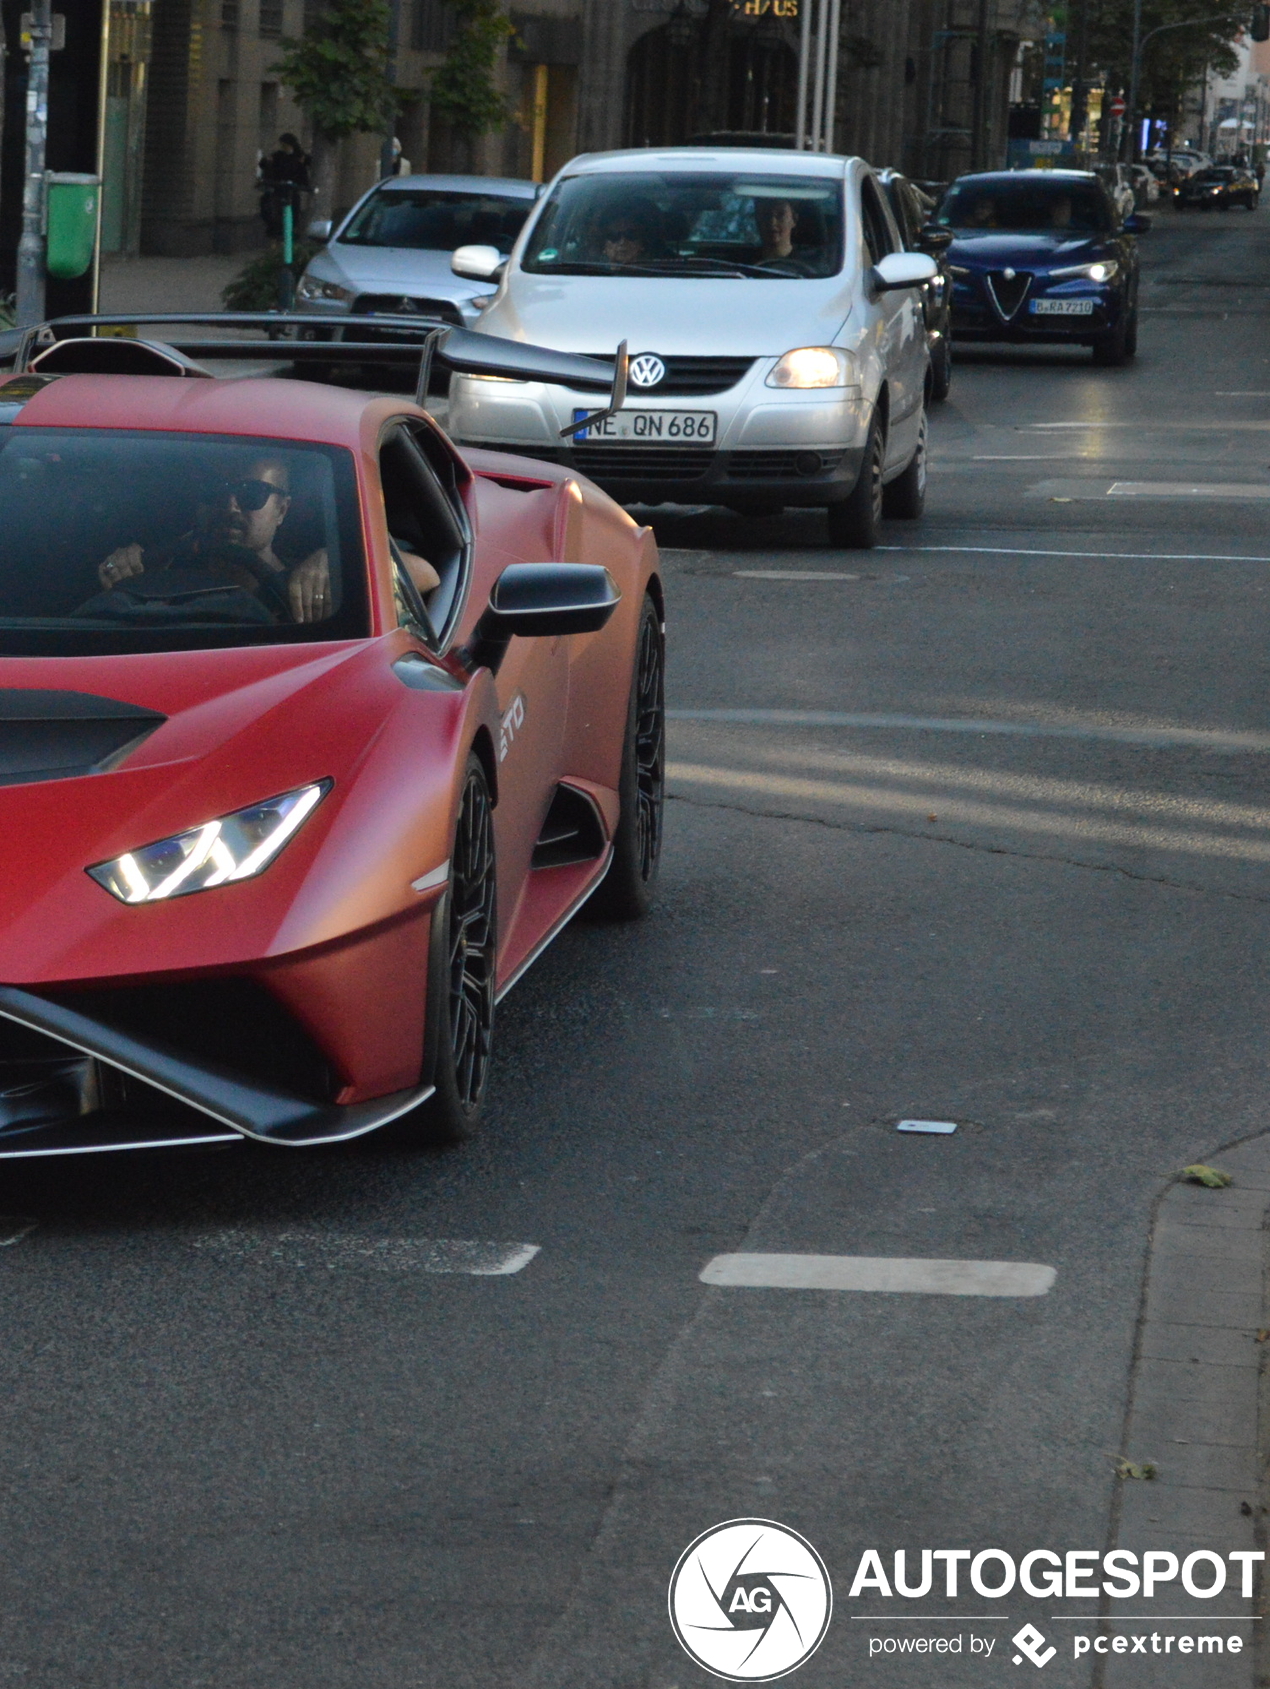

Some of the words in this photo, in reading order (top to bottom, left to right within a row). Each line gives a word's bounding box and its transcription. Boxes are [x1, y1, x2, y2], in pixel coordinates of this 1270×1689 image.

[630, 355, 665, 387] VW
[588, 414, 617, 436] NE
[634, 415, 663, 436] QN
[668, 416, 710, 438] 686
